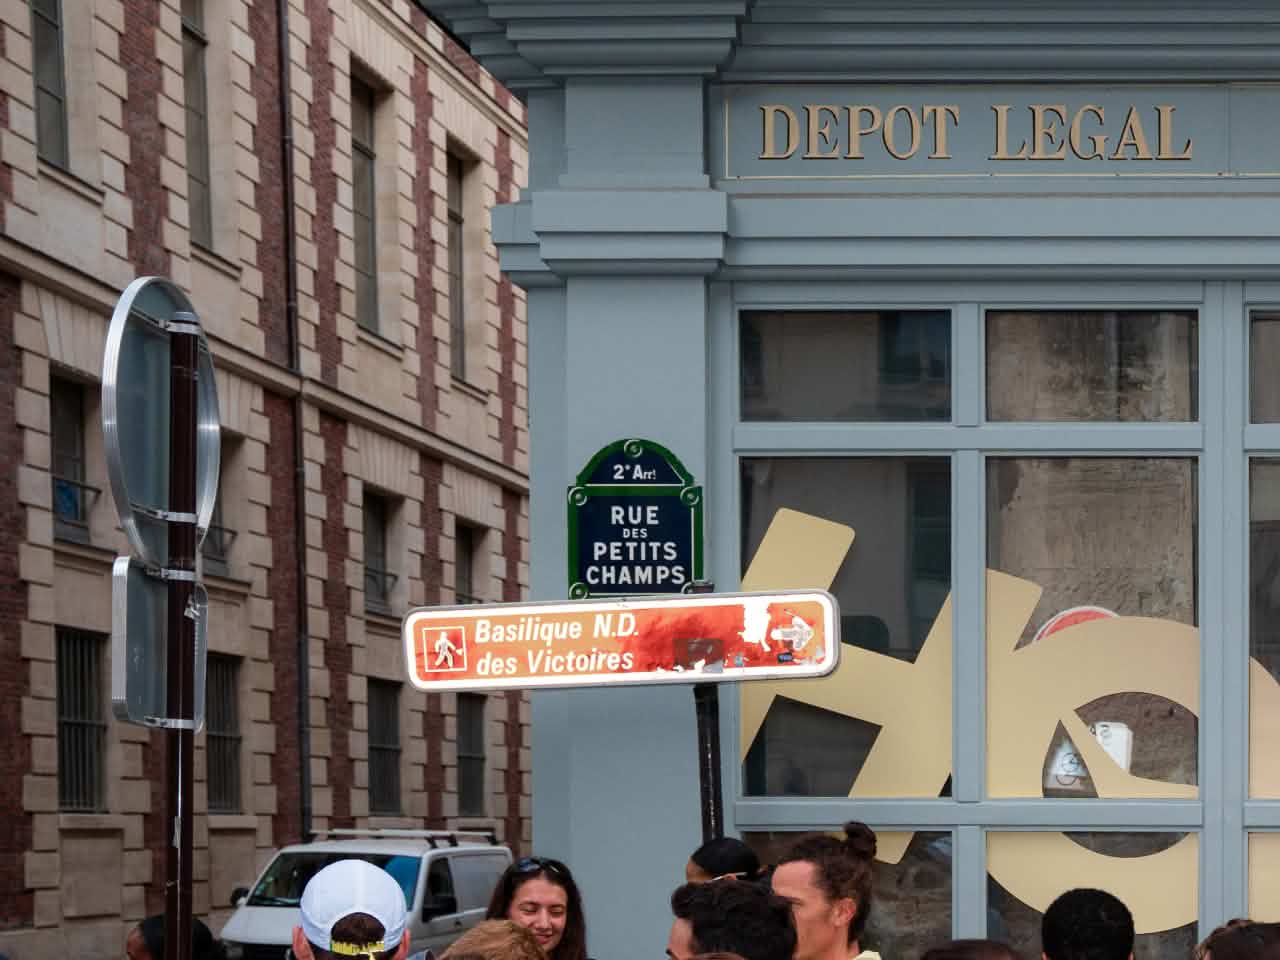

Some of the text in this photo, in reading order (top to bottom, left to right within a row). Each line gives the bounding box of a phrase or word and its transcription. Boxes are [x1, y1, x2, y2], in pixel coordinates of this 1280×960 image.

[758, 103, 1193, 161] DEPOT LEGAL
[610, 505, 660, 526] RUE
[622, 528, 648, 539] DES
[592, 541, 678, 562] PETITS
[585, 565, 686, 585] CHAMPS
[474, 612, 640, 647] Basilique N.D.
[476, 647, 635, 676] des Victoires
